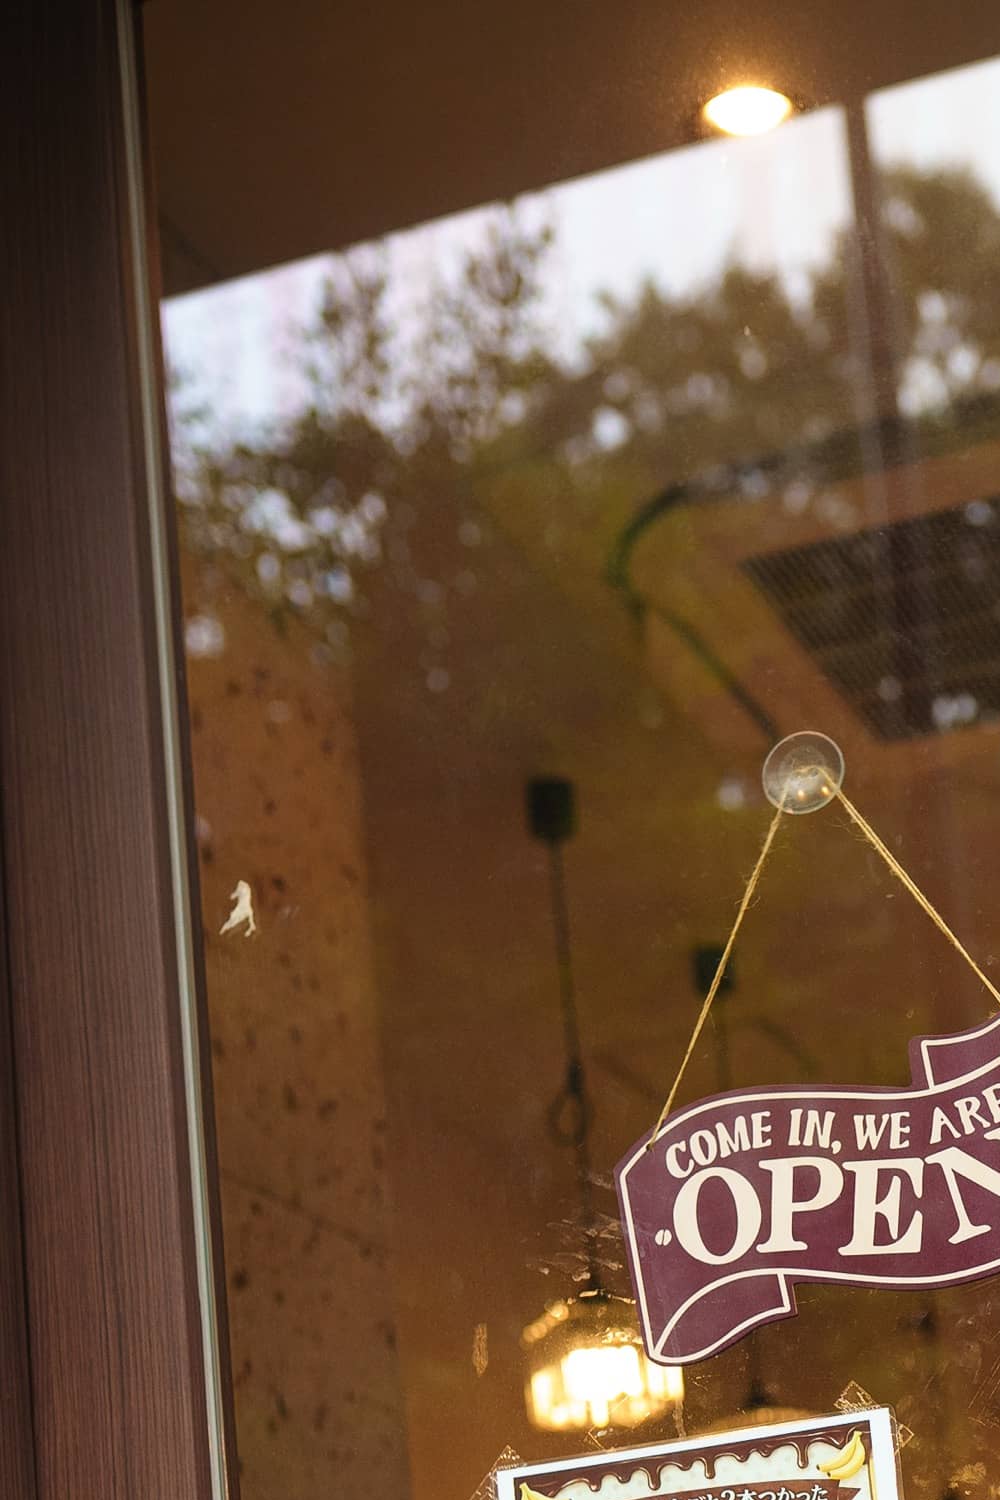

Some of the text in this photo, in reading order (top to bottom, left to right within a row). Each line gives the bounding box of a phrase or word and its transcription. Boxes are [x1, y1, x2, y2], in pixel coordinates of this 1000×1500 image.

[665, 1110, 772, 1178] COME
[787, 1108, 843, 1155] IN,
[853, 1111, 910, 1150] WE
